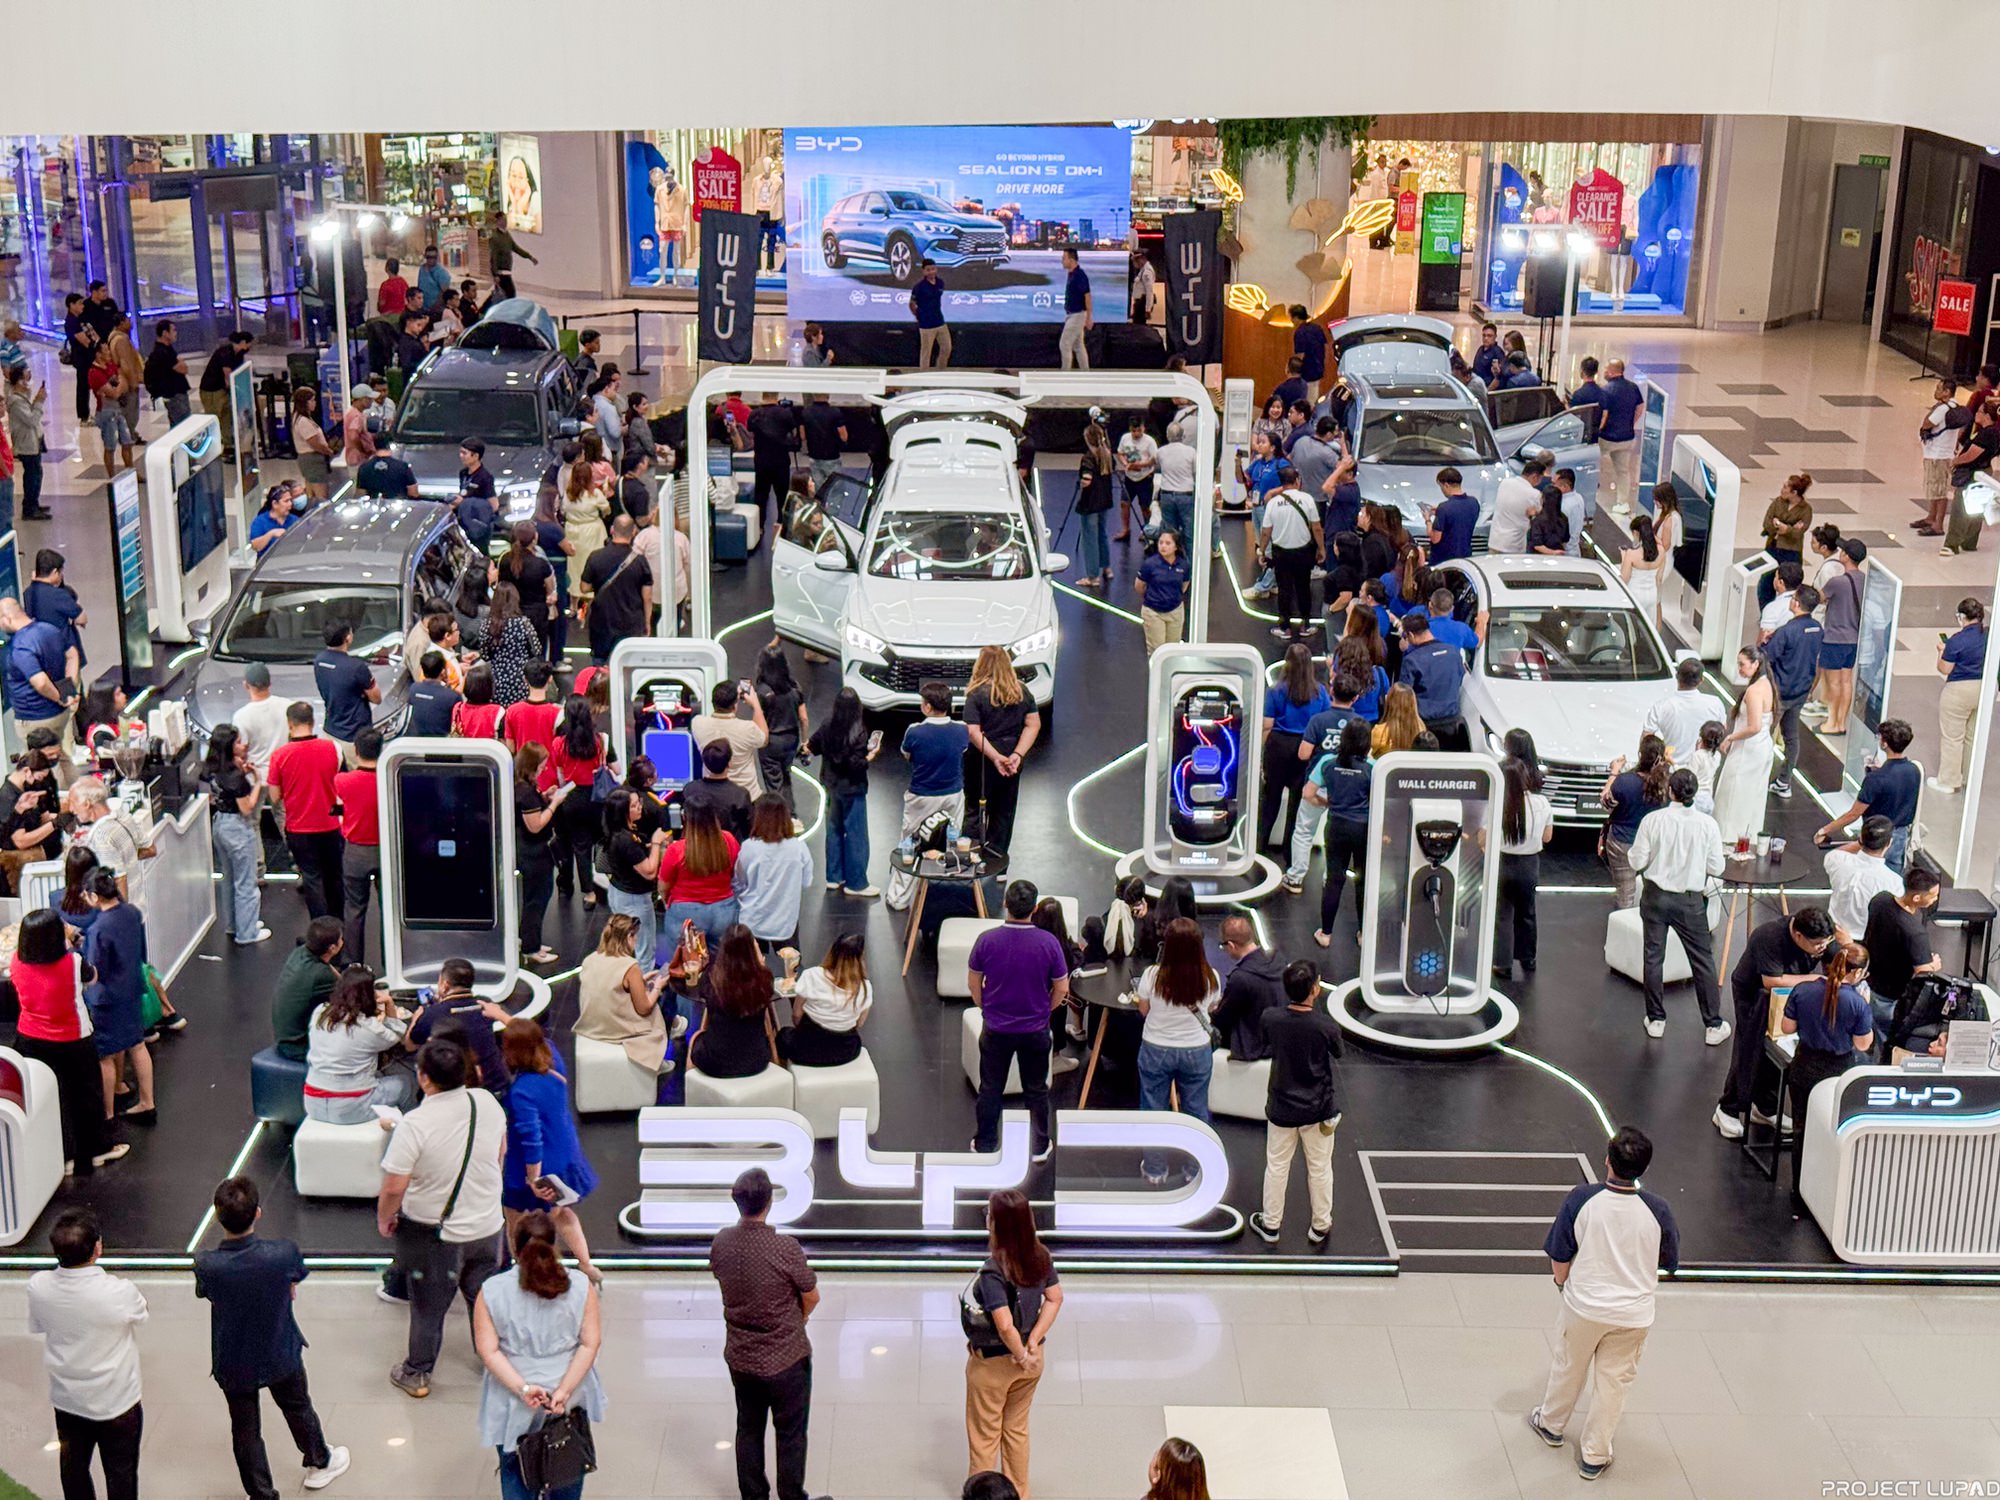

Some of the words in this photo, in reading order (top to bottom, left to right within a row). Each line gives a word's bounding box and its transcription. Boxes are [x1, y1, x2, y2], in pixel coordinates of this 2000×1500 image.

[795, 136, 862, 151] BYD
[1038, 154, 1065, 162] HYBRID
[698, 169, 736, 180] CLEARANCE
[959, 165, 1041, 175] SEALION
[698, 180, 736, 199] SALE
[996, 183, 1030, 194] DRIVE
[1032, 184, 1064, 194] MORE
[1577, 192, 1618, 203] CLEARANCE
[1577, 201, 1616, 222] SALE
[1598, 223, 1615, 235] OFF
[714, 232, 740, 340] BYD
[1180, 241, 1202, 346] BYD
[1940, 295, 1970, 312] SALE
[1398, 780, 1426, 789] WALL
[1428, 780, 1477, 790] CHARGER
[1868, 1086, 1962, 1106] BYD
[638, 1106, 1229, 1227] BYD
